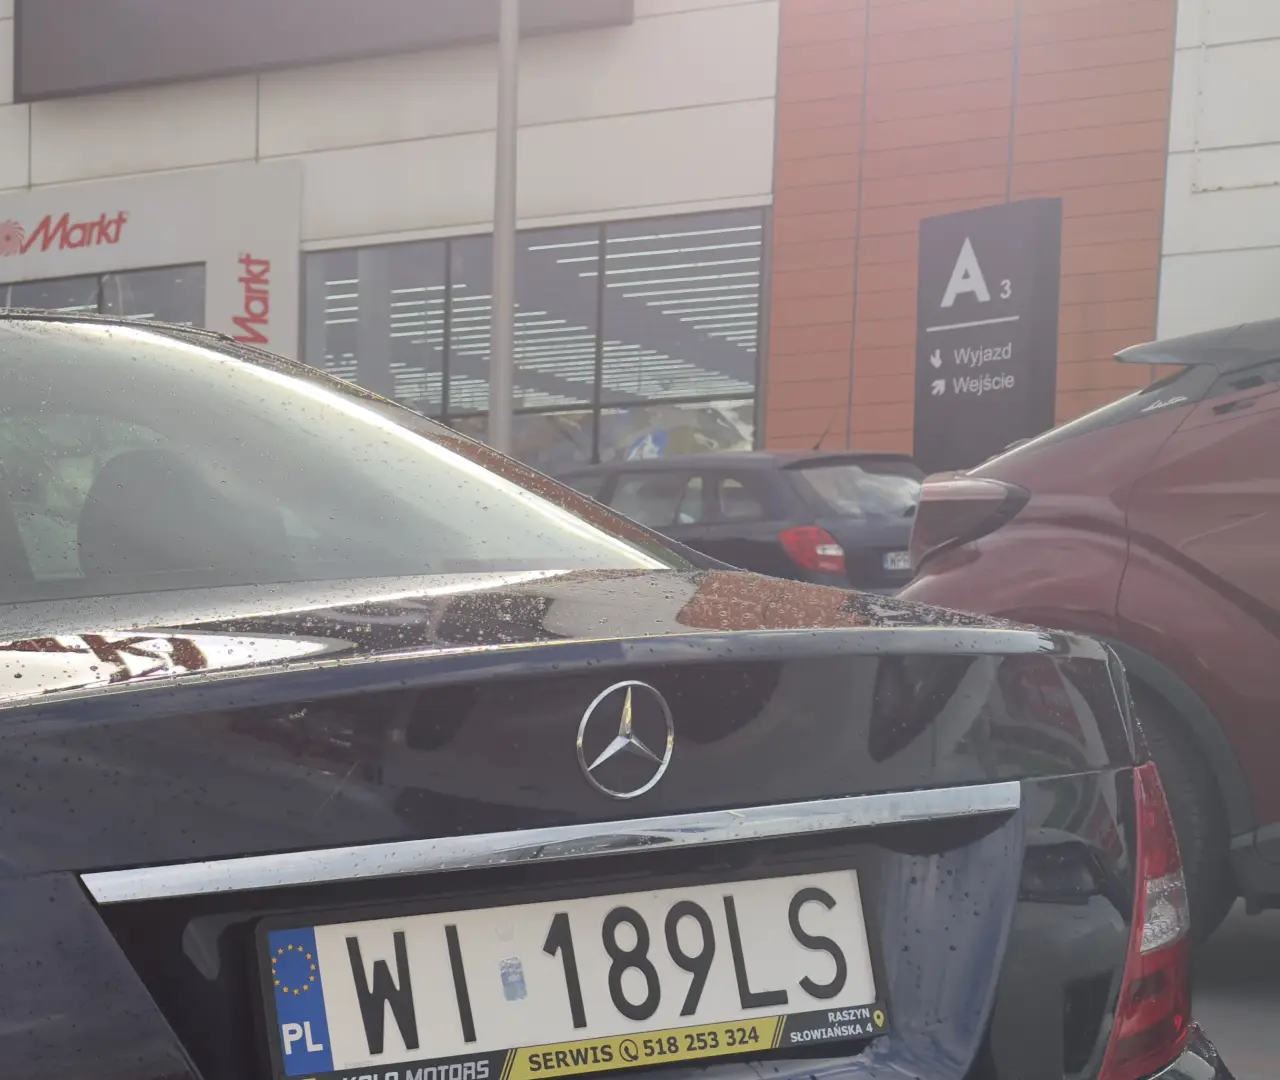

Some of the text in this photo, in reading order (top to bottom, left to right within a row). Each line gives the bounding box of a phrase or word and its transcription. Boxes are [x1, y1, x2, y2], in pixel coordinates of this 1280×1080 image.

[19, 210, 128, 255] Markt
[940, 236, 1012, 308] A 3
[232, 253, 270, 344] Markt
[953, 342, 1012, 368] Wyjazd
[952, 372, 1016, 396] Wejście
[344, 886, 848, 1056] WI 189LS
[790, 1022, 873, 1043] SŁOWIAŃSKA 4
[827, 1007, 871, 1024] RASZYN
[281, 1020, 324, 1056] PL
[528, 1025, 760, 1073] SERWIS 518 253 324
